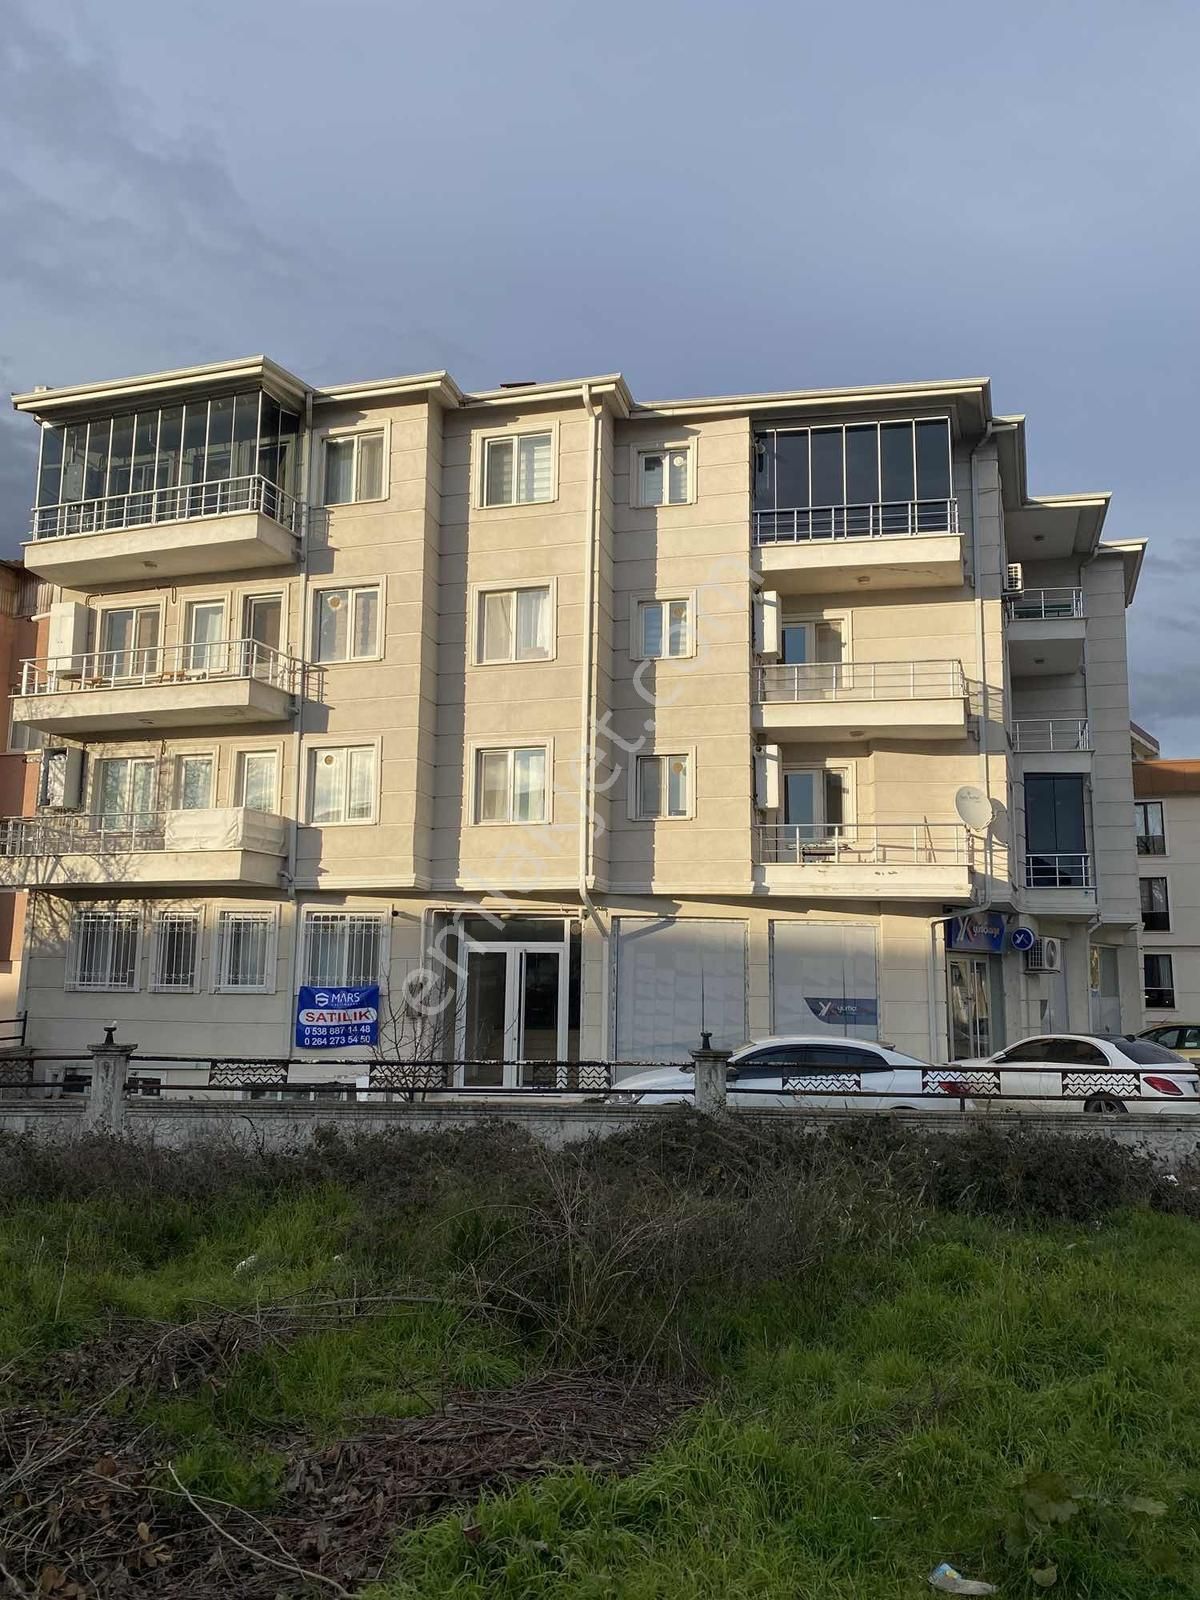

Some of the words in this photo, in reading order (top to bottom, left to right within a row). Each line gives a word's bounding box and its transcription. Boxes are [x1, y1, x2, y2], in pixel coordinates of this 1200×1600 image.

[331, 992, 360, 1003] MARS
[305, 1010, 370, 1022] SATILIK
[304, 1027, 310, 1036] 0
[311, 1027, 327, 1035] 538
[329, 1026, 344, 1034] 887
[359, 1025, 371, 1033] 48
[304, 1037, 310, 1046] 0
[311, 1037, 327, 1046] 264
[329, 1036, 345, 1045] 273
[347, 1036, 359, 1044] 54
[360, 1035, 371, 1043] 50
